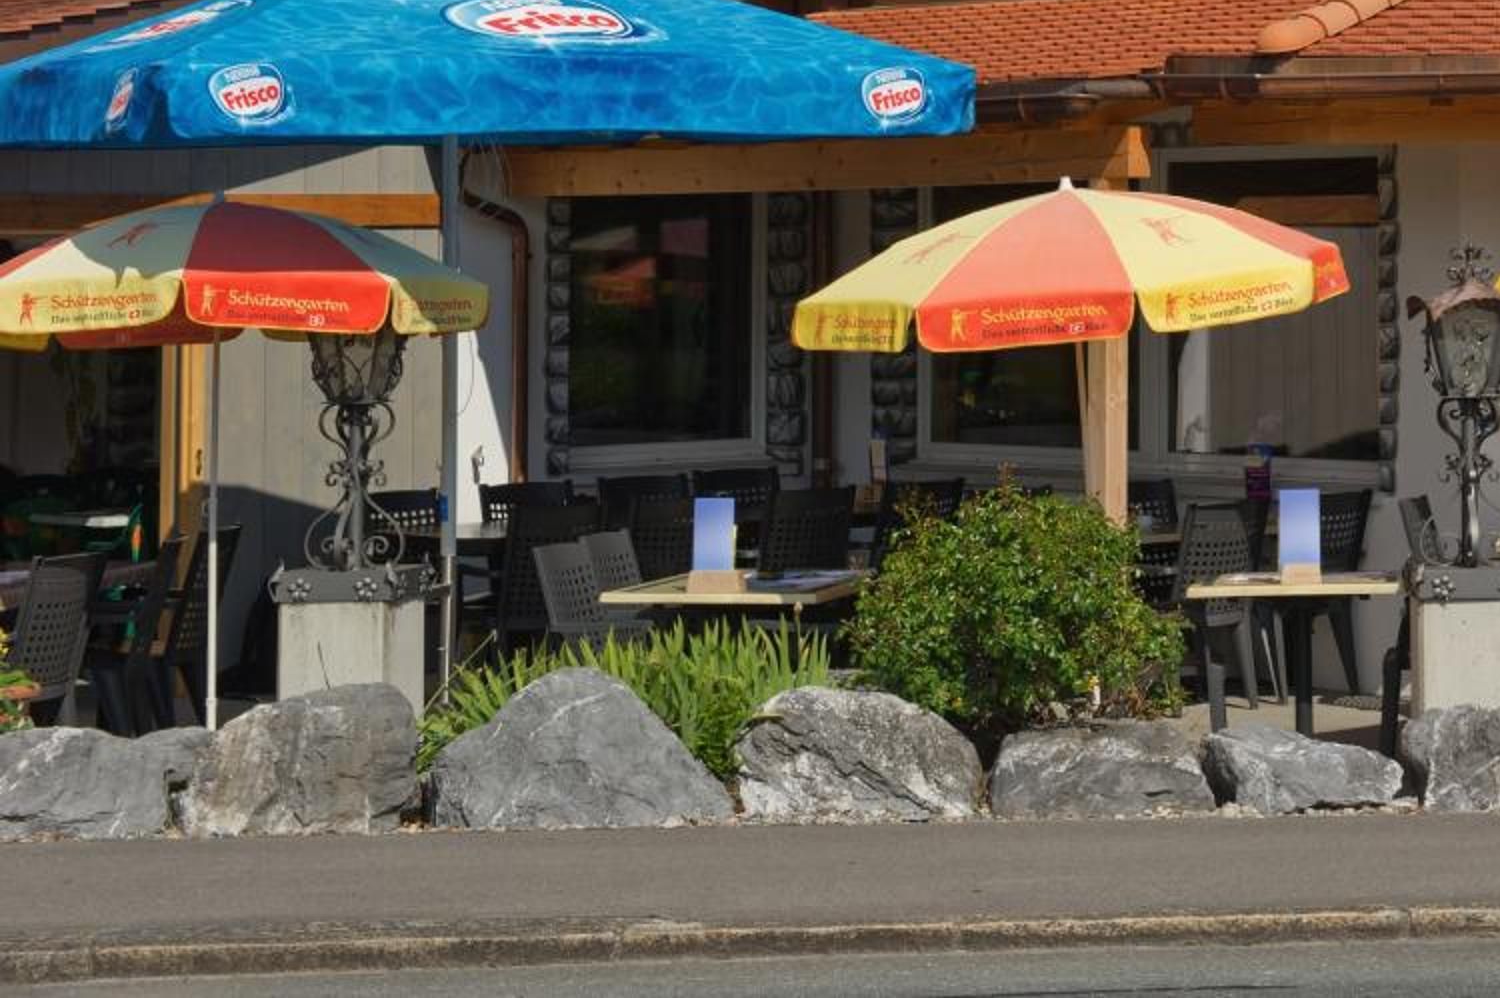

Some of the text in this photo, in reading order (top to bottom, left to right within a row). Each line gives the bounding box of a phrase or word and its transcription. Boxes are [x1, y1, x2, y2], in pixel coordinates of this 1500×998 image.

[484, 10, 619, 33] Frisco
[222, 84, 279, 111] Frisco
[871, 87, 921, 111] Frisco
[227, 288, 350, 314] Schützengarten
[979, 304, 1108, 325] Schützengarten
